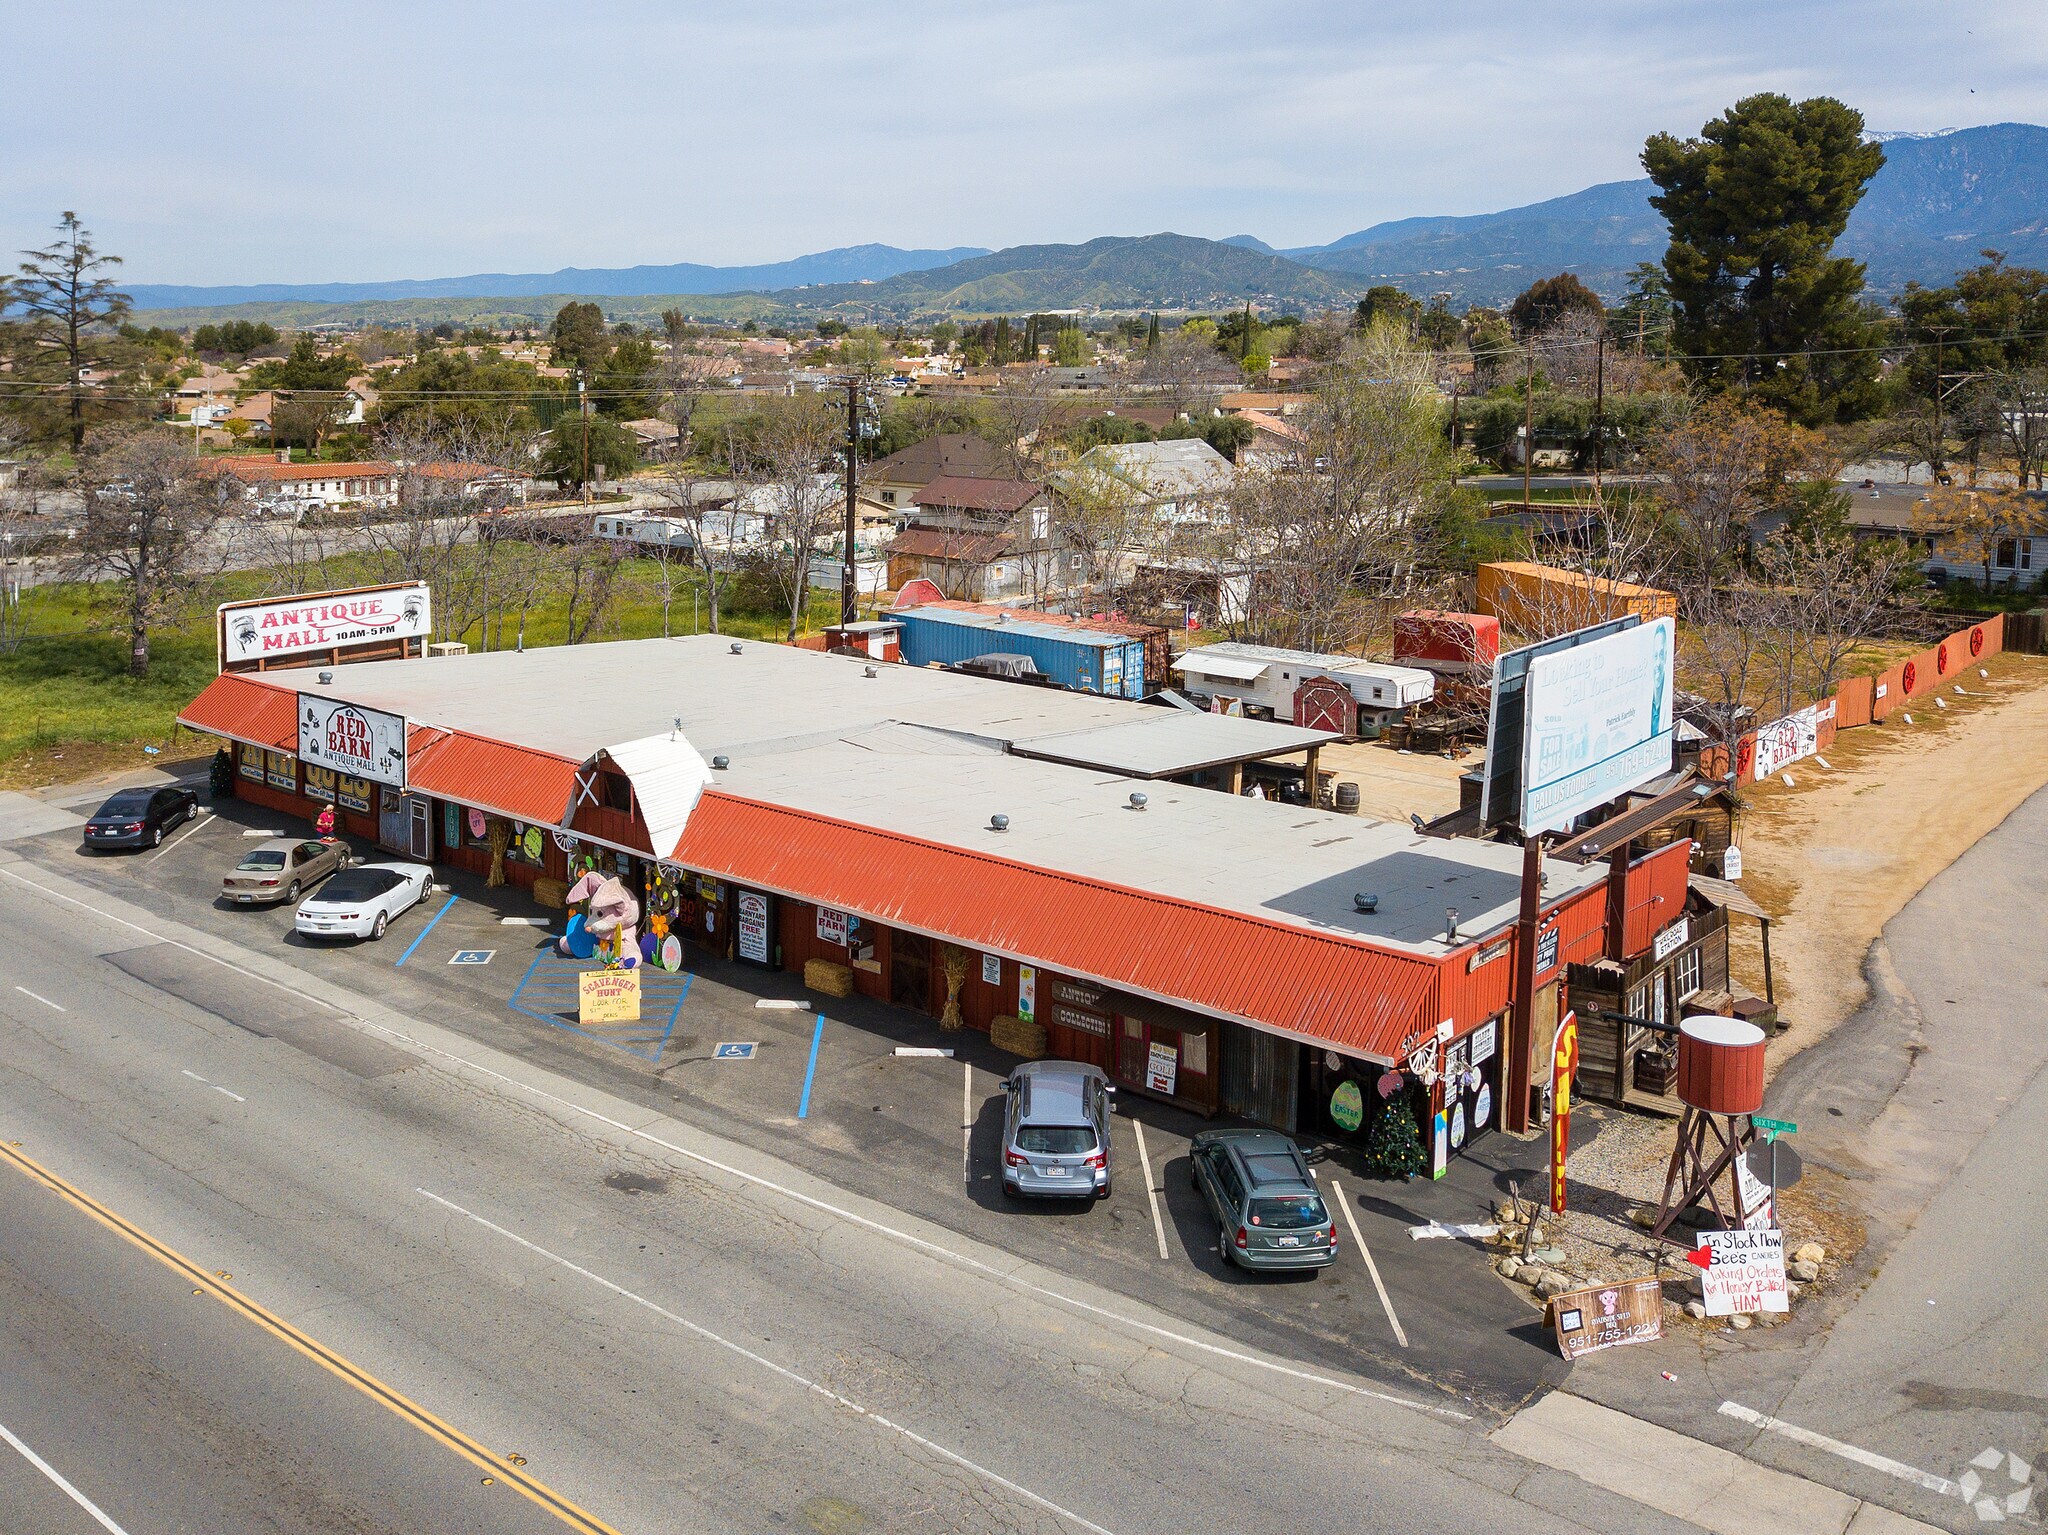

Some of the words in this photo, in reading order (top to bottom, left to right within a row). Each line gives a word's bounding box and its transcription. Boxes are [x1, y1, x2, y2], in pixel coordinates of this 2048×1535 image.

[260, 599, 384, 629] ANTIQUE
[262, 628, 331, 651] MALL
[336, 714, 367, 740] RED
[1544, 715, 1562, 723] SOLD
[328, 731, 371, 760] BARN
[1543, 735, 1561, 758] FOR
[1778, 726, 1795, 747] RED
[323, 749, 355, 767] ANTIQUE
[356, 760, 377, 772] MALL
[1606, 763, 1618, 779] 951
[1618, 735, 1669, 781] 769-6240
[1773, 740, 1797, 764] BARN
[1540, 752, 1561, 779] SALE
[1533, 789, 1554, 813] CALL
[1553, 786, 1565, 806] US
[823, 908, 843, 922] RED
[741, 923, 761, 935] FREE
[1660, 933, 1682, 955] STATION
[582, 976, 636, 995] SCAVENGER
[596, 988, 622, 997] HUNT
[592, 999, 608, 1007] LOOK
[1060, 986, 1100, 1007] ANTIQ
[1149, 1061, 1175, 1076] GOLD
[1753, 1117, 1777, 1129] SIXTH
[1703, 1234, 1721, 1247] In
[1723, 1232, 1758, 1249] Stock
[1710, 1249, 1747, 1265] See's
[1751, 1250, 1780, 1260] CANDIES
[1708, 1267, 1743, 1282] Taking
[1746, 1263, 1784, 1279] Orders
[1720, 1280, 1753, 1295] Honey
[1755, 1278, 1785, 1293] Baked
[1731, 1293, 1763, 1312] HAM
[1568, 1322, 1659, 1349] 951-755-1221
